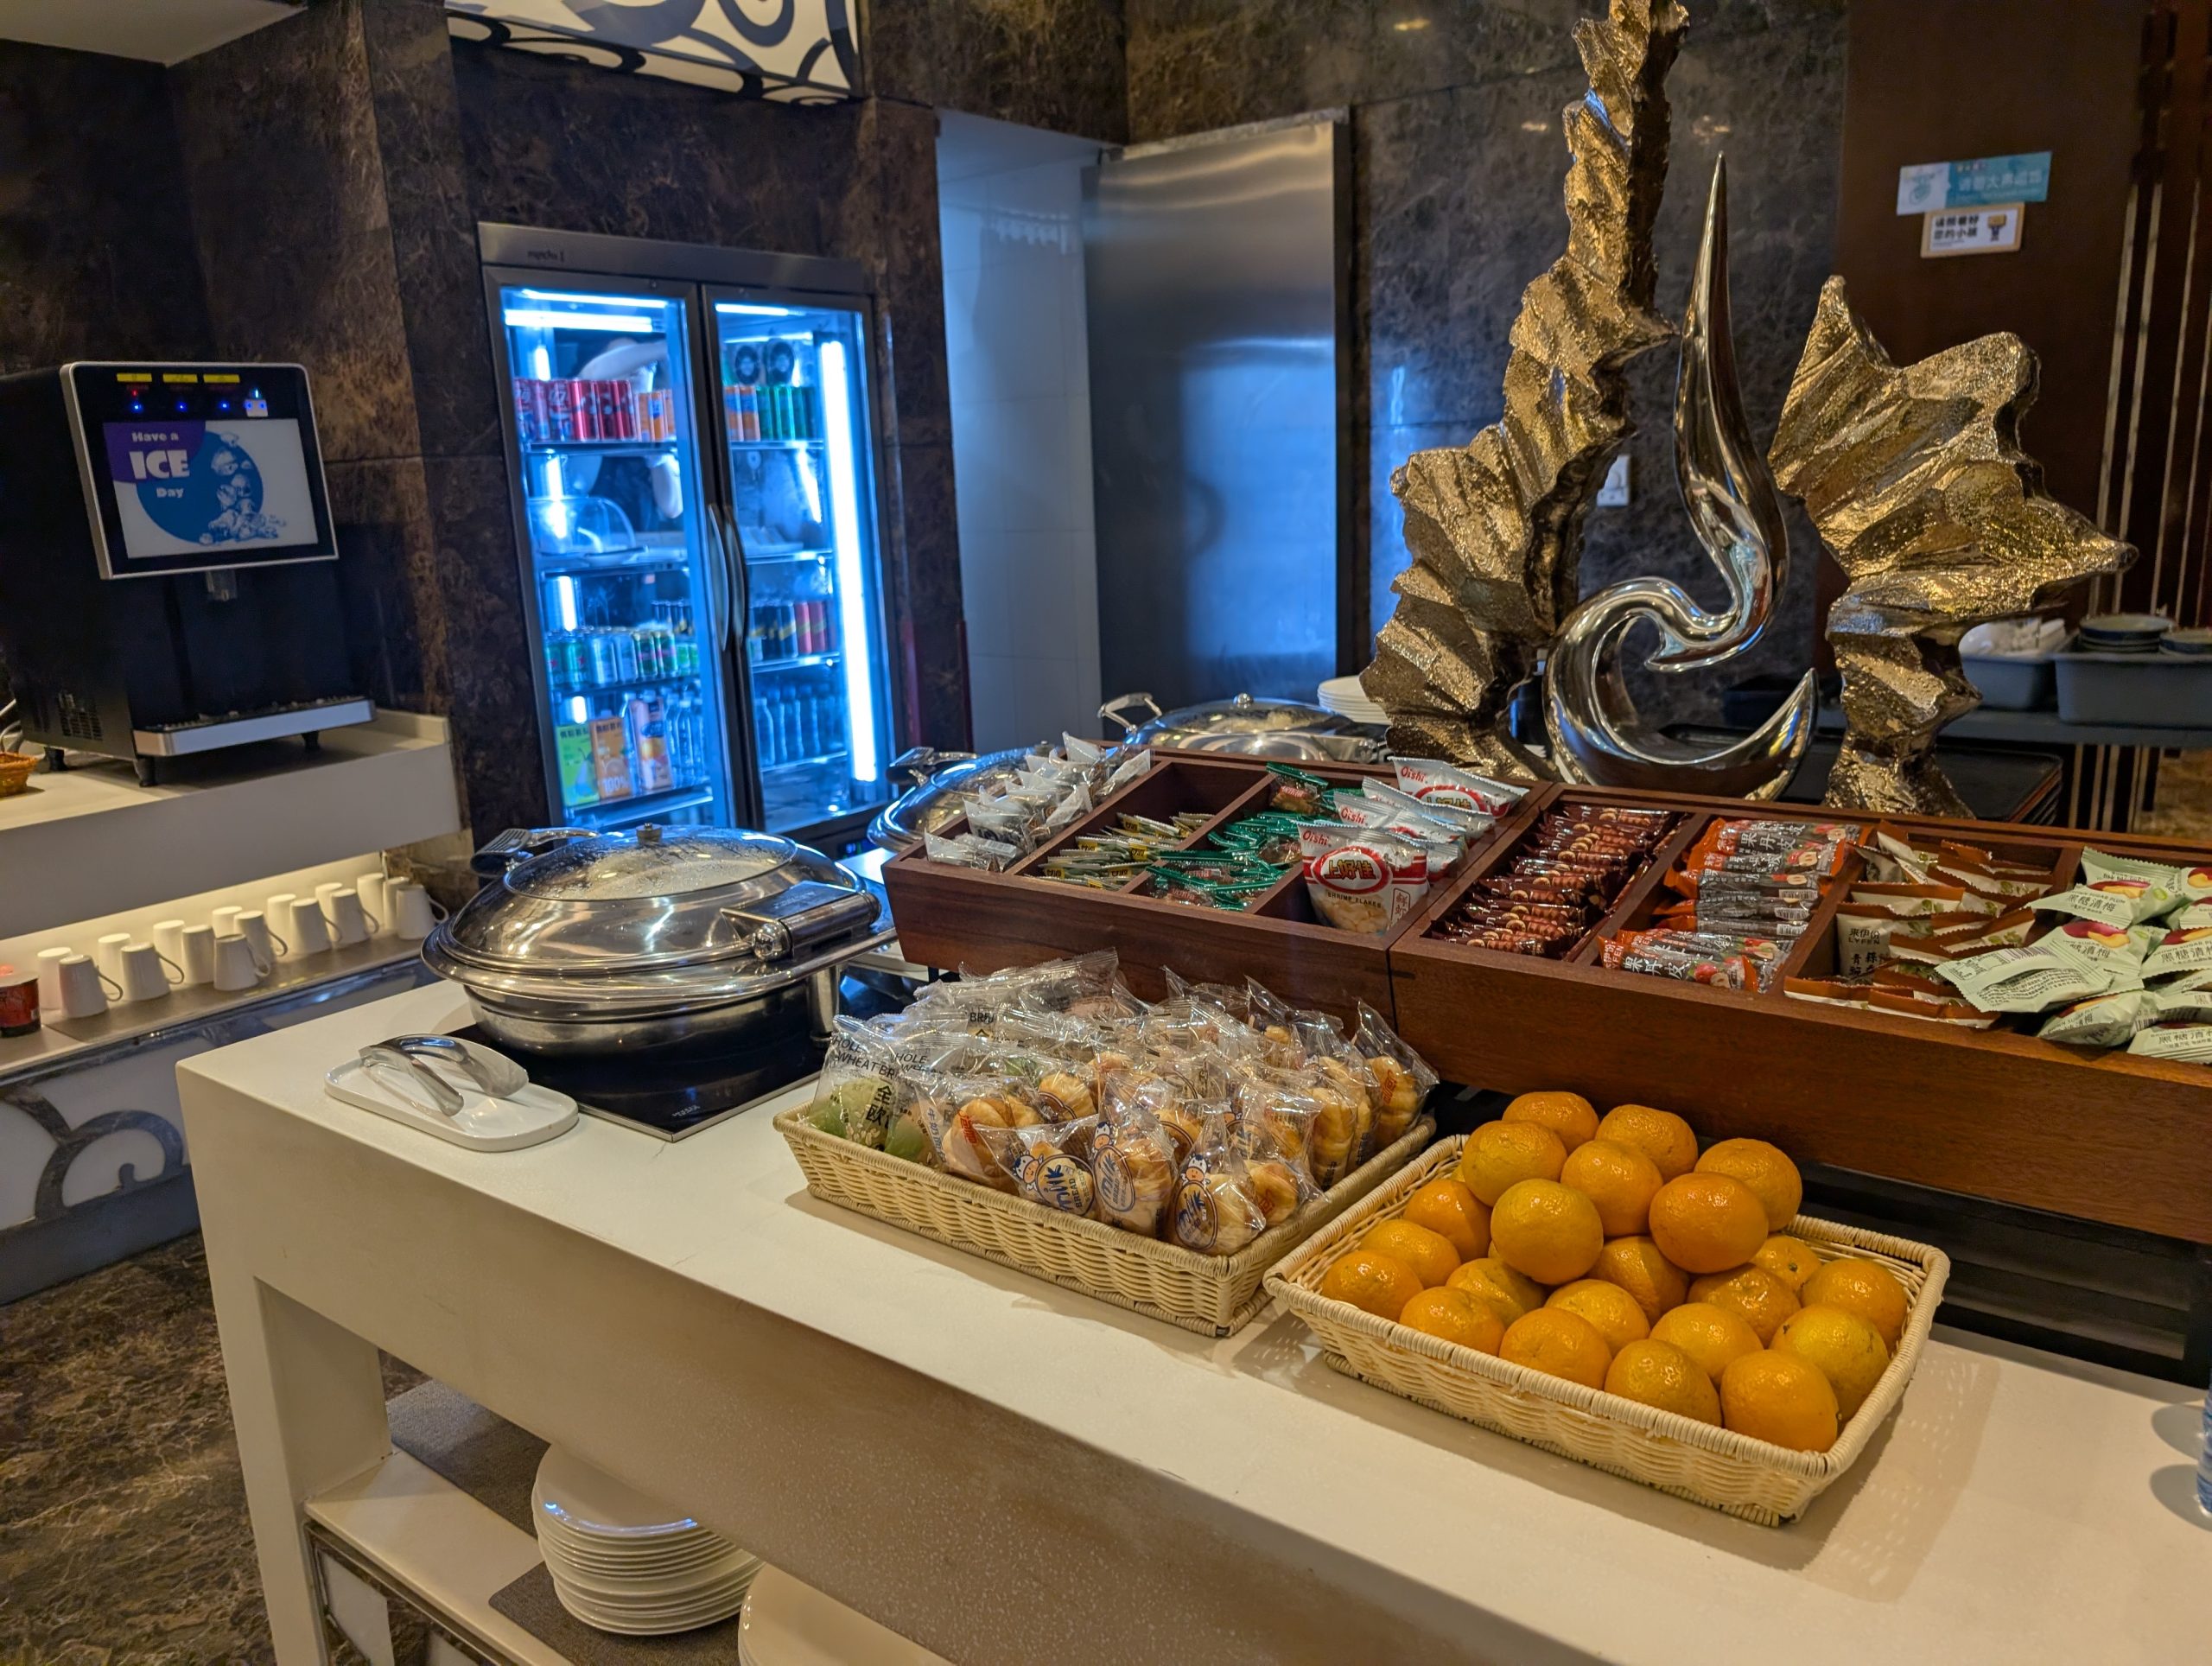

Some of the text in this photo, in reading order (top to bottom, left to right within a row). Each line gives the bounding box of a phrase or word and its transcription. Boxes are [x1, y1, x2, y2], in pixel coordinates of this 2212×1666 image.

[131, 432, 168, 442] Have
[130, 449, 190, 480] ICE
[156, 487, 184, 499] Day
[1401, 765, 1425, 782] Oishi
[1340, 806, 1366, 824] Oishi
[1302, 830, 1329, 846] Oishi
[1740, 832, 1796, 851] 果丹皮
[1323, 859, 1377, 881] 上好佳
[1327, 892, 1382, 909] SHRIMP FLAKES
[1612, 945, 1624, 968] YFEN
[1623, 956, 1691, 980] 果丹皮
[837, 1050, 879, 1071] WHEAT
[1044, 1164, 1073, 1211] milk
[1068, 1178, 1082, 1208] BREAD
